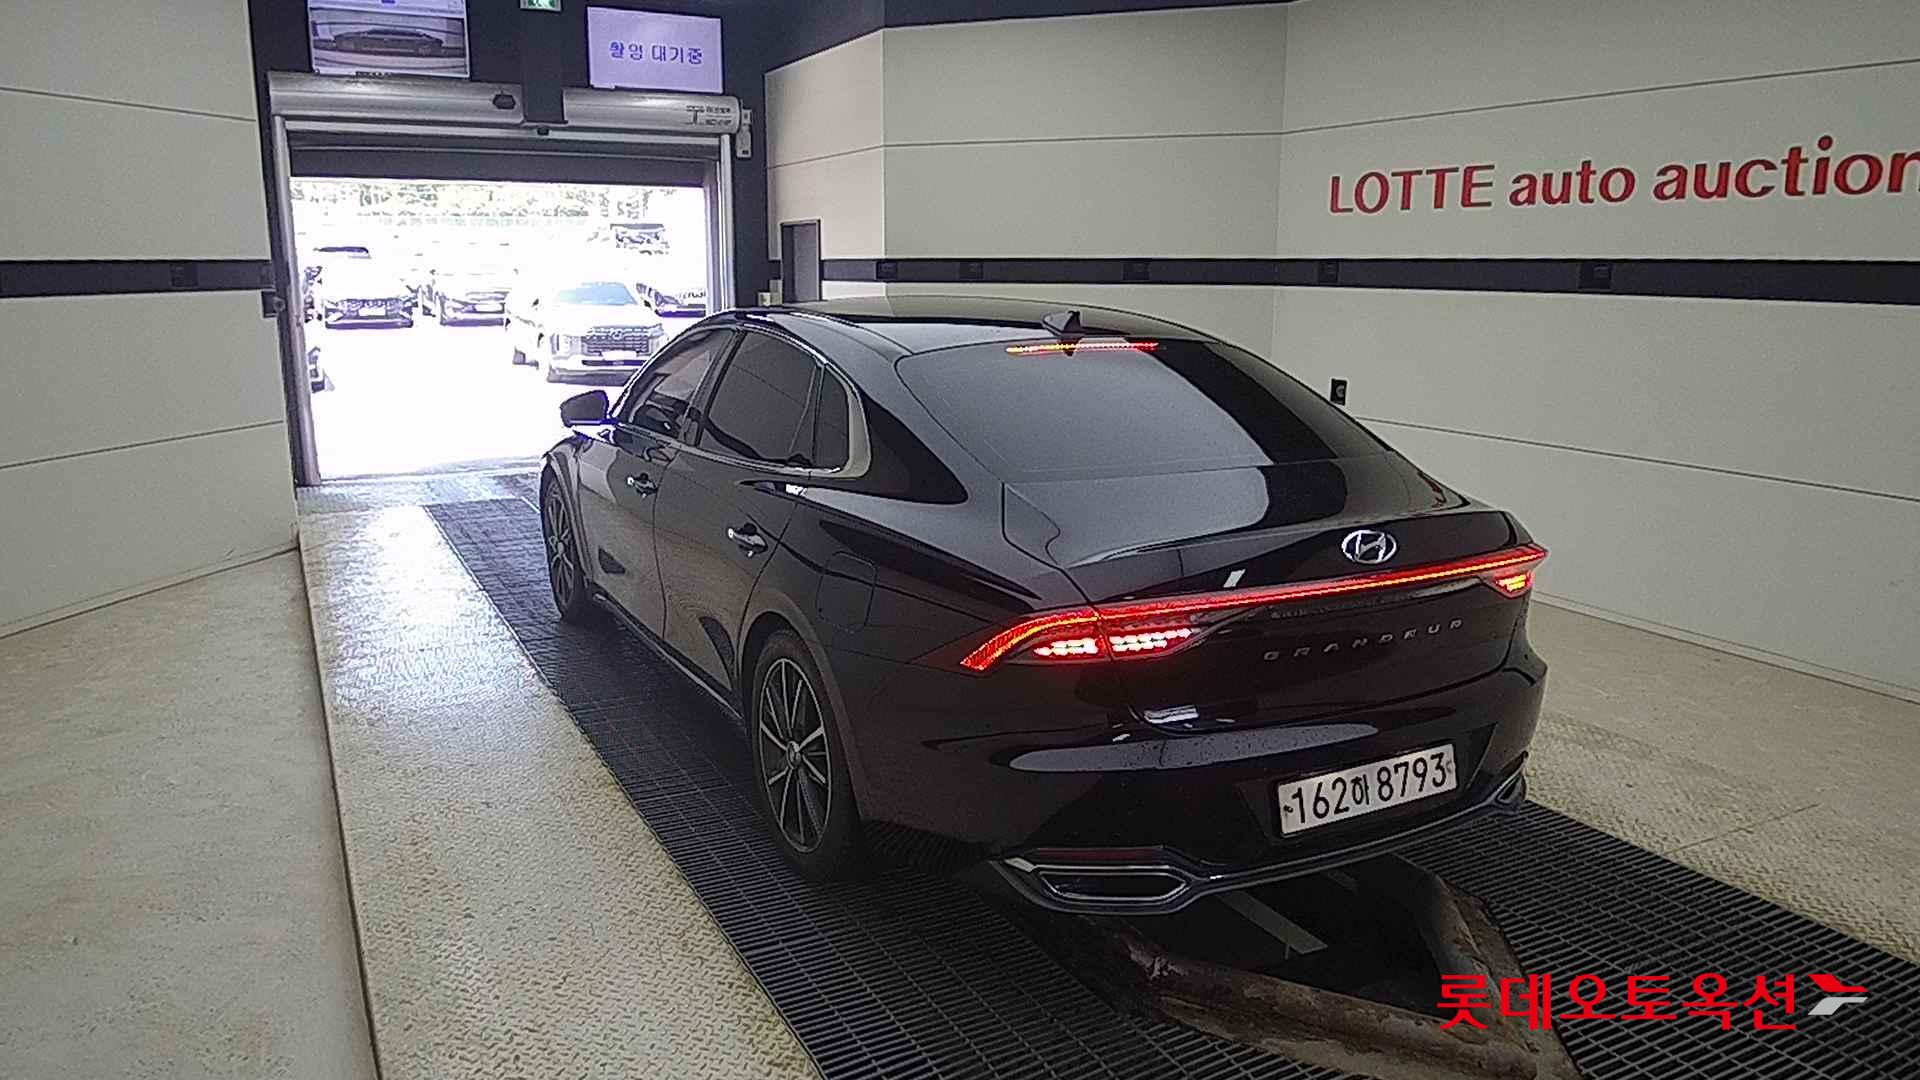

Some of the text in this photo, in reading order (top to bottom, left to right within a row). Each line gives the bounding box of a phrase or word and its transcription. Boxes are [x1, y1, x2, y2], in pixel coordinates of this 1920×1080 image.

[1329, 164, 1495, 214] LOTTE
[1509, 160, 1635, 207] auto
[1263, 618, 1463, 661] GRANDEUR
